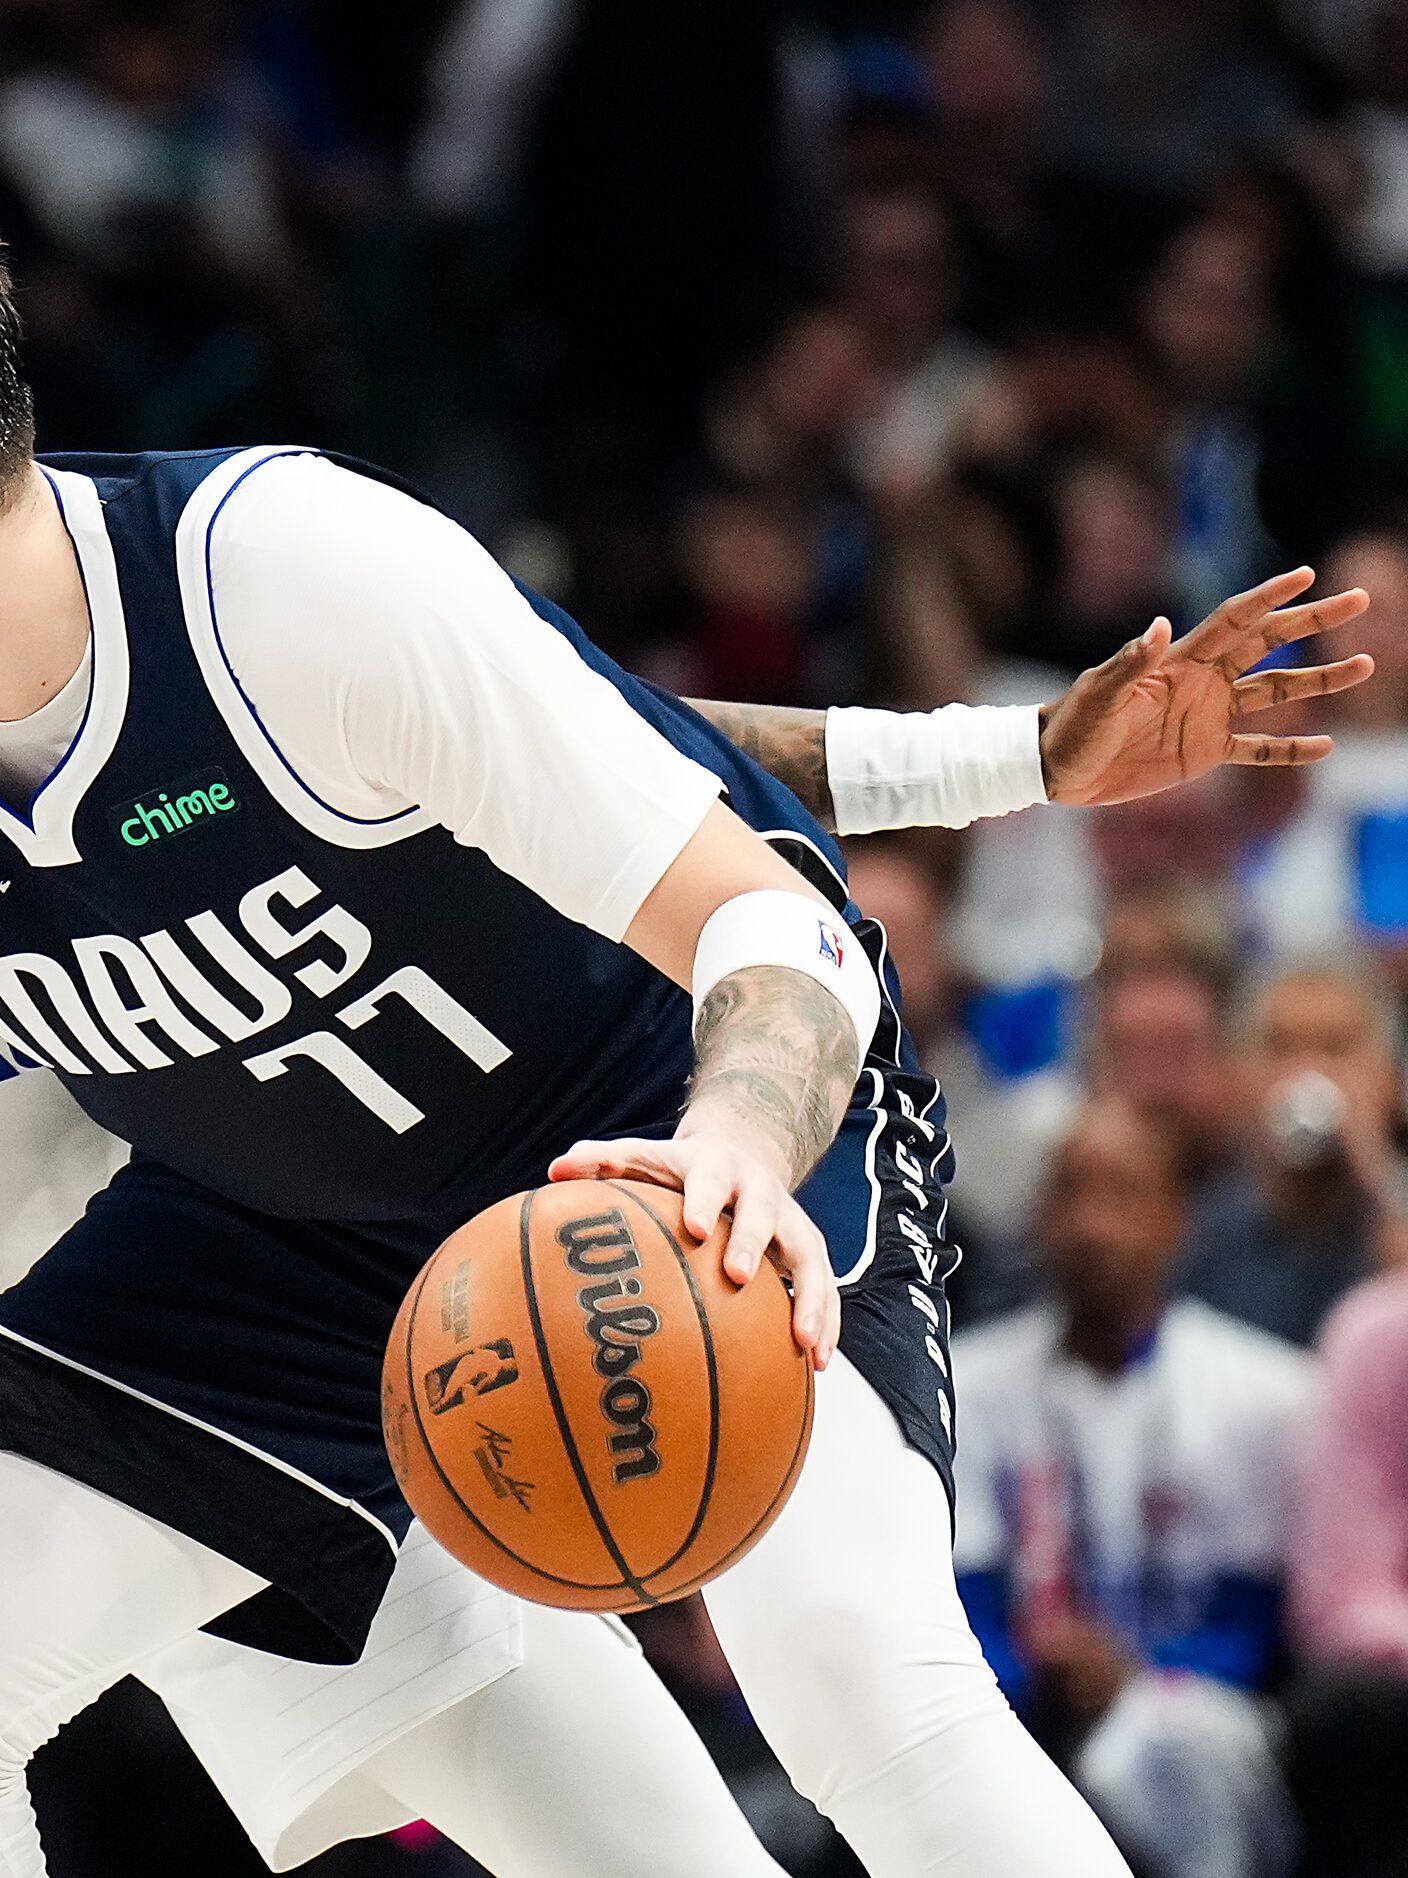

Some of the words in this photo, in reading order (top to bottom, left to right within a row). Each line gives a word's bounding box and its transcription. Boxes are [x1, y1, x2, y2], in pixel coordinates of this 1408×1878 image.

[120, 782, 237, 848] chime
[242, 964, 514, 1135] 77
[554, 1206, 662, 1485] Wilson
